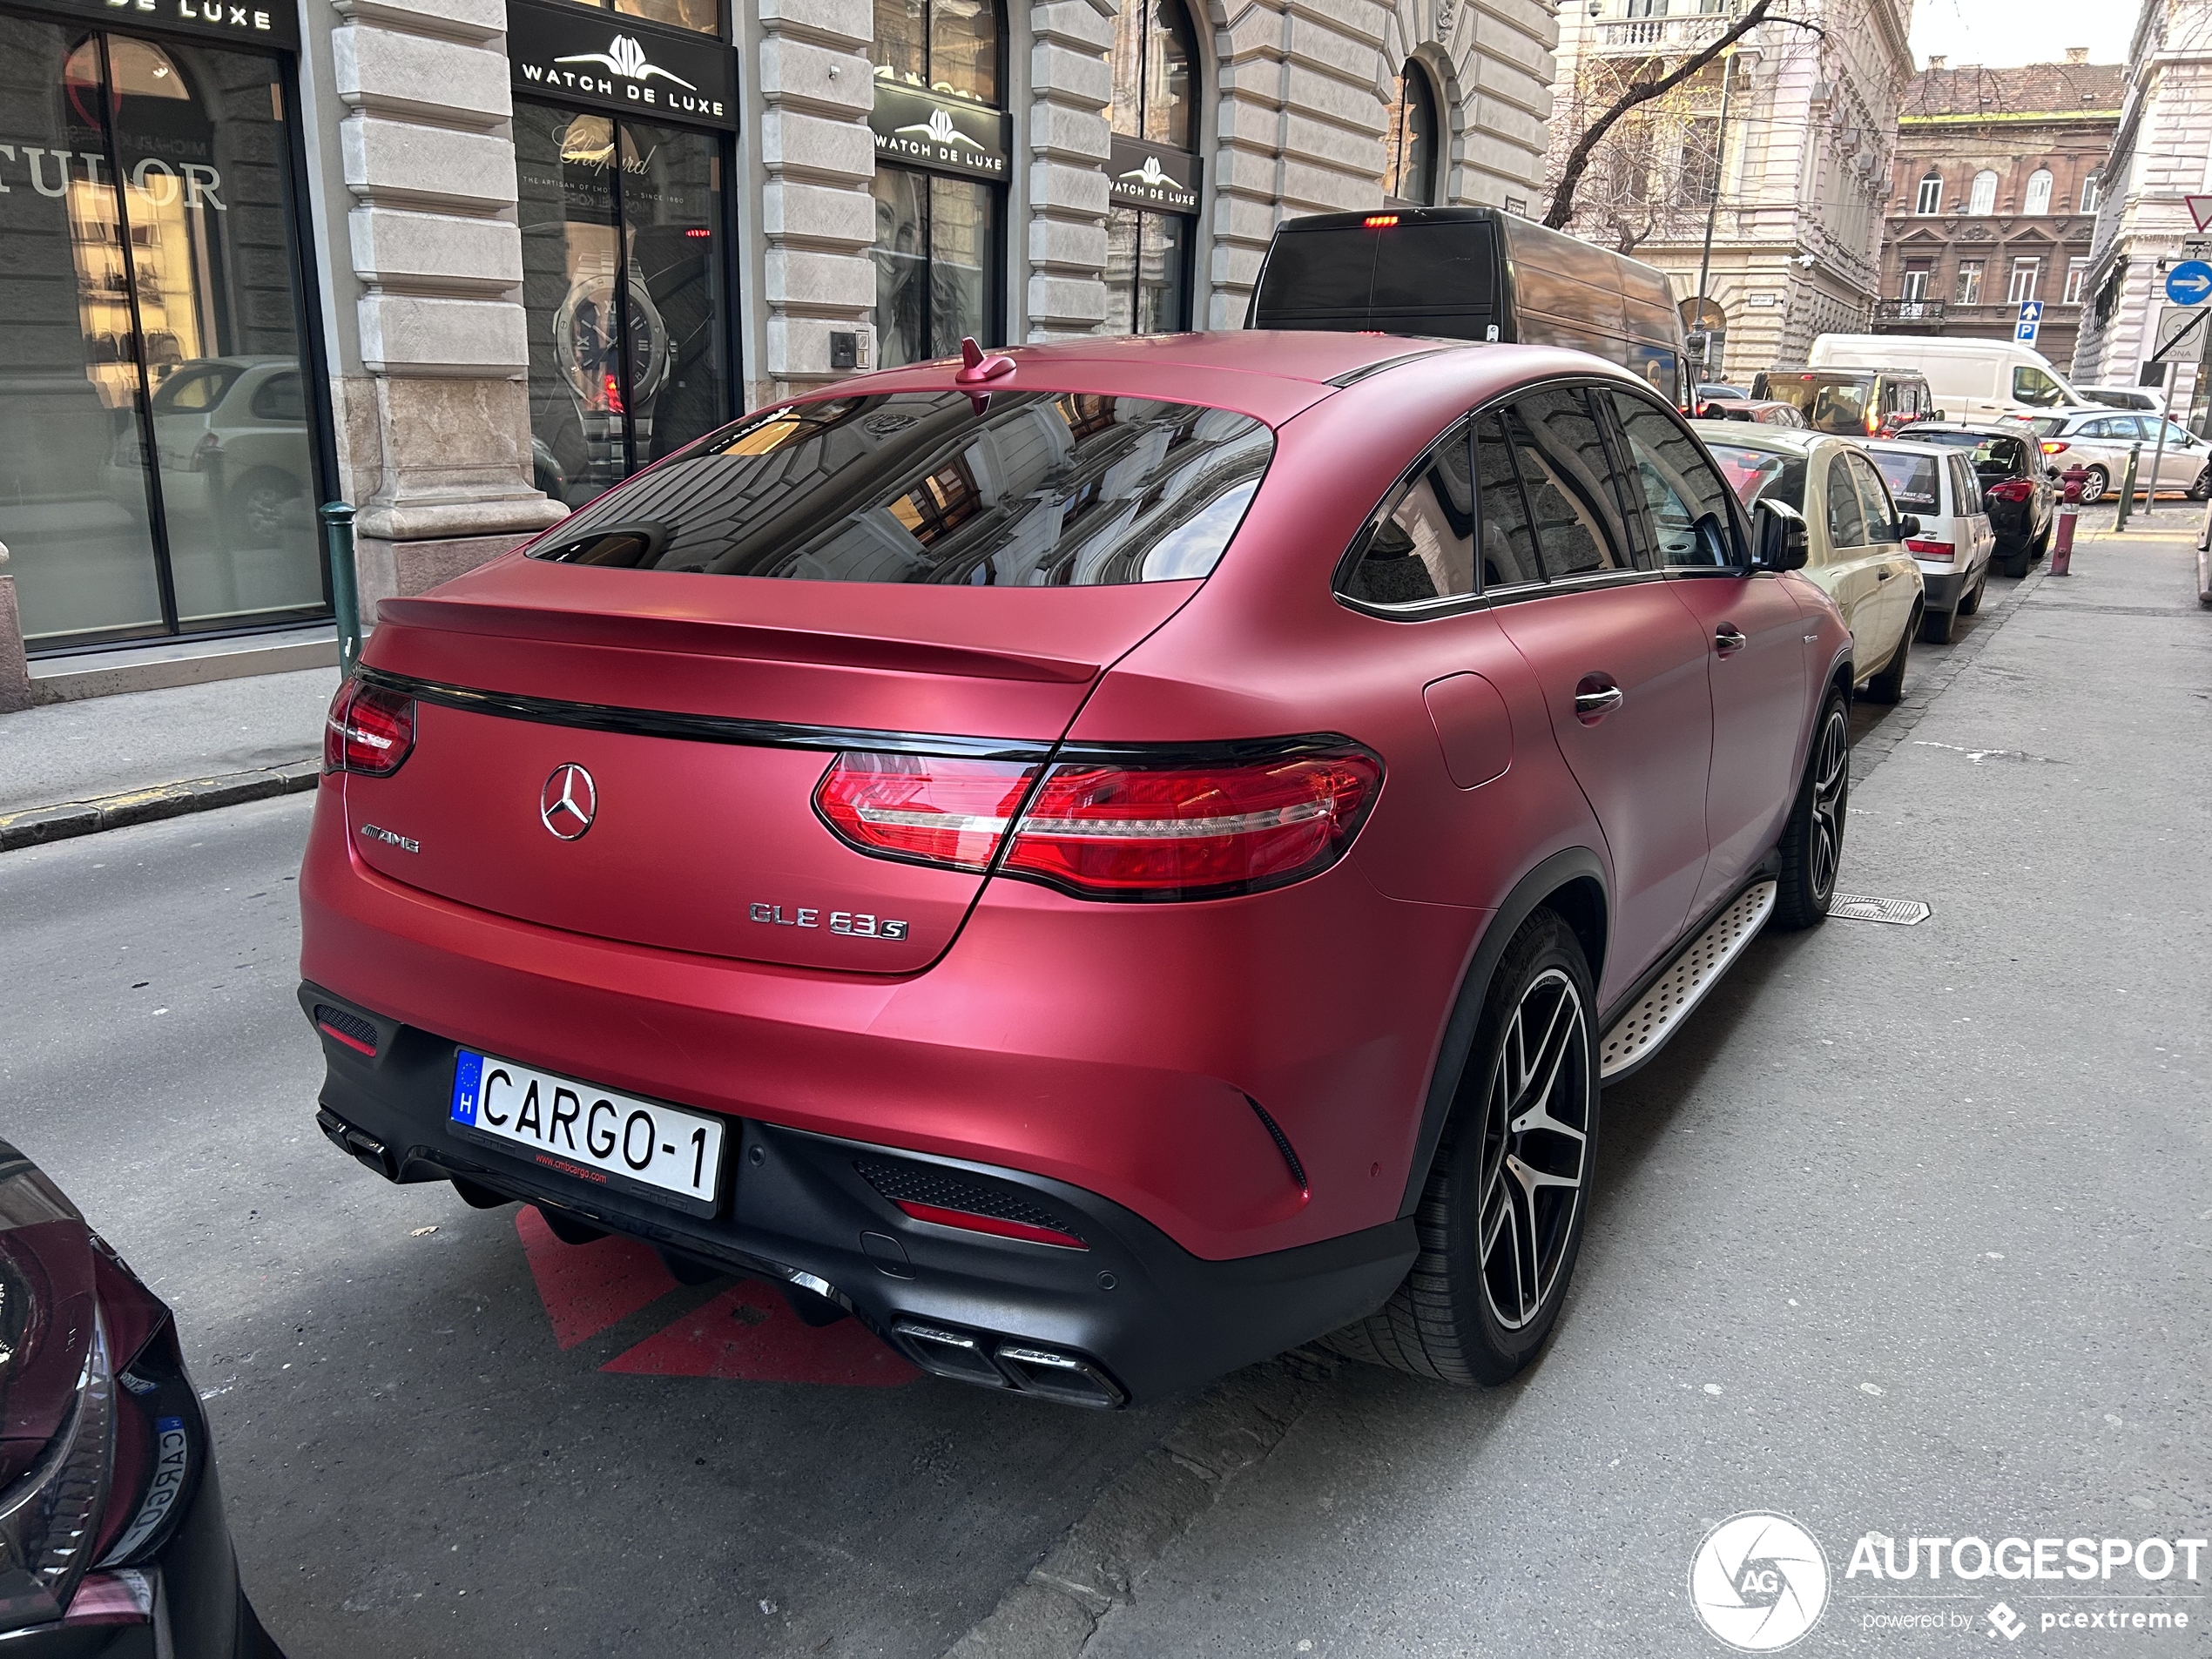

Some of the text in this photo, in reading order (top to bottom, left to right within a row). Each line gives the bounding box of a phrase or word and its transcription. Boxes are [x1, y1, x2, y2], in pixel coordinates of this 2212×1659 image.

[180, 0, 271, 30] LUXE
[523, 64, 724, 116] WATCH DE LUXE
[552, 125, 657, 177] Choprd
[874, 134, 1002, 171] WATCH DE LUXE
[523, 176, 538, 185] THE
[542, 179, 575, 189] ARTISAN
[640, 192, 663, 201] SINCE
[1109, 180, 1195, 206] WATCH DE LUXE
[2020, 325, 2033, 338] P
[2163, 348, 2192, 357] ZÓNA
[749, 902, 819, 928] GLE
[460, 1092, 473, 1115] H
[483, 1068, 709, 1189] CARGO-1
[536, 1154, 607, 1184] www.cmbcargo.com
